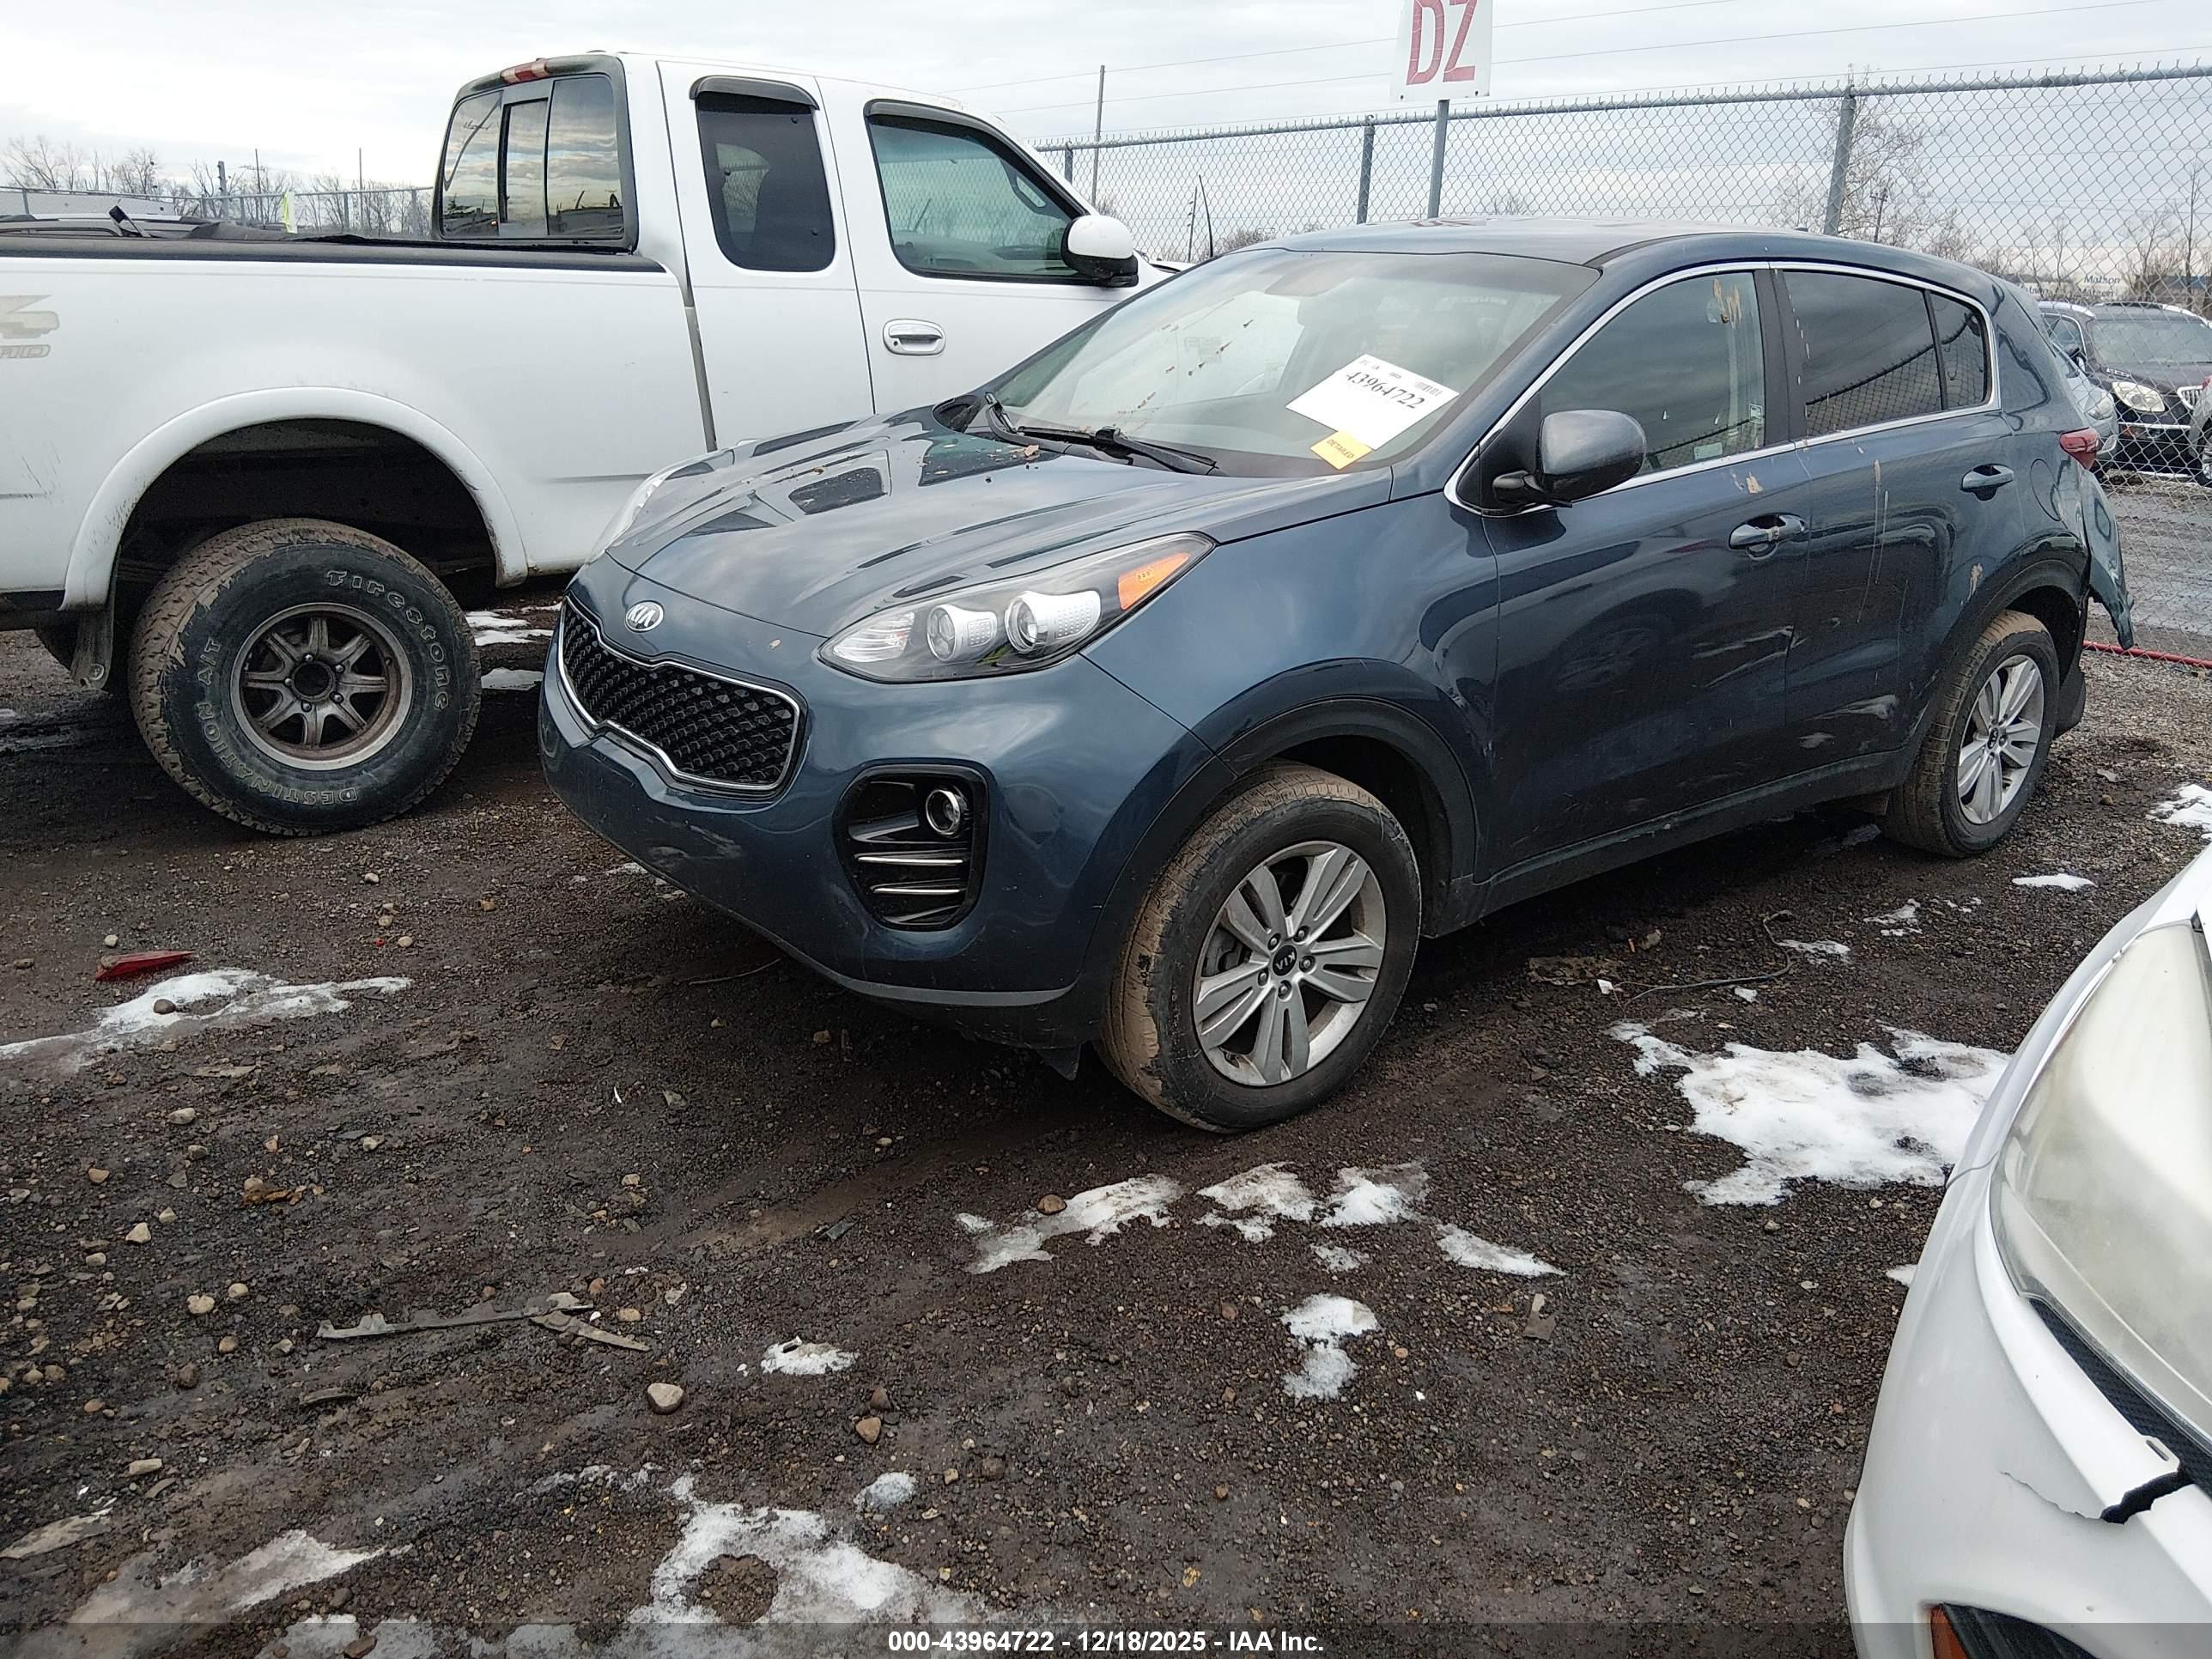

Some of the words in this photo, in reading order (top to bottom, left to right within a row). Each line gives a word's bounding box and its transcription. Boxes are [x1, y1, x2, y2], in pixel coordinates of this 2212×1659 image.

[2082, 274, 2121, 285] Matson
[1346, 371, 1425, 410] 43964722
[1326, 439, 1356, 459] DETAILED
[627, 603, 657, 628] KIA
[324, 568, 453, 710] Firestone
[196, 638, 223, 688] A/T
[196, 700, 359, 806] DESTINATION
[1275, 951, 1296, 970] KIA
